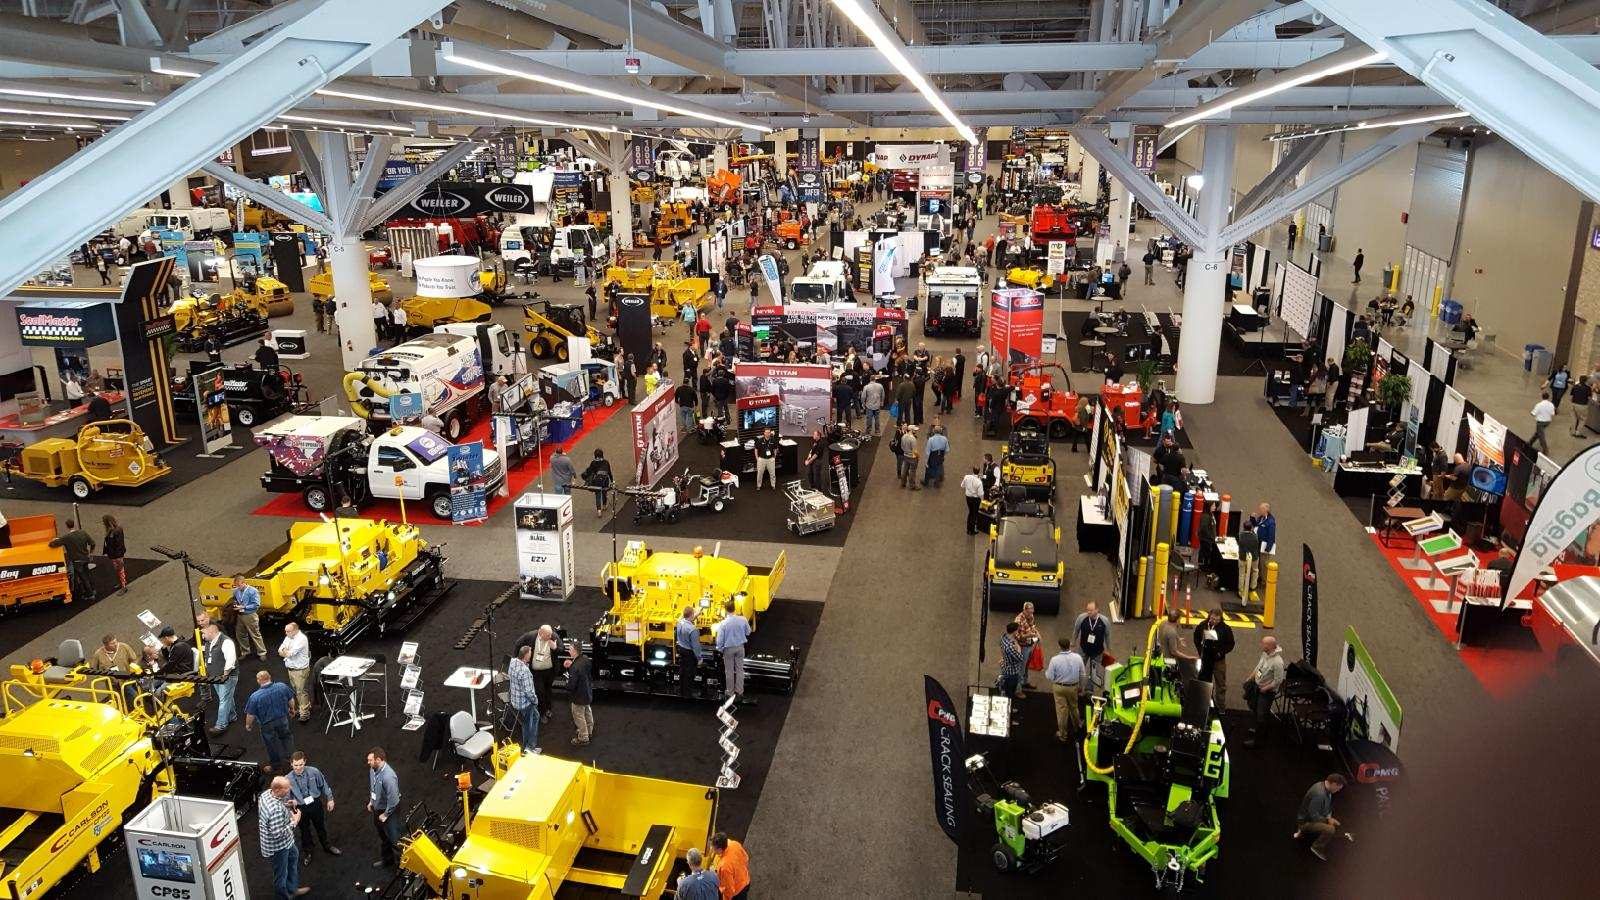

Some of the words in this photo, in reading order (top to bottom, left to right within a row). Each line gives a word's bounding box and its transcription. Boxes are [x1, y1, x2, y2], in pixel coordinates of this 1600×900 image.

[421, 199, 459, 208] WEILER
[497, 194, 523, 204] WEILER
[20, 313, 79, 327] SealMaster
[774, 369, 798, 377] TITAN
[754, 399, 771, 407] TITAN
[939, 721, 951, 776] CRACK
[943, 776, 957, 828] SEALING
[69, 800, 109, 837] CARLSON
[152, 841, 186, 850] CARLSON
